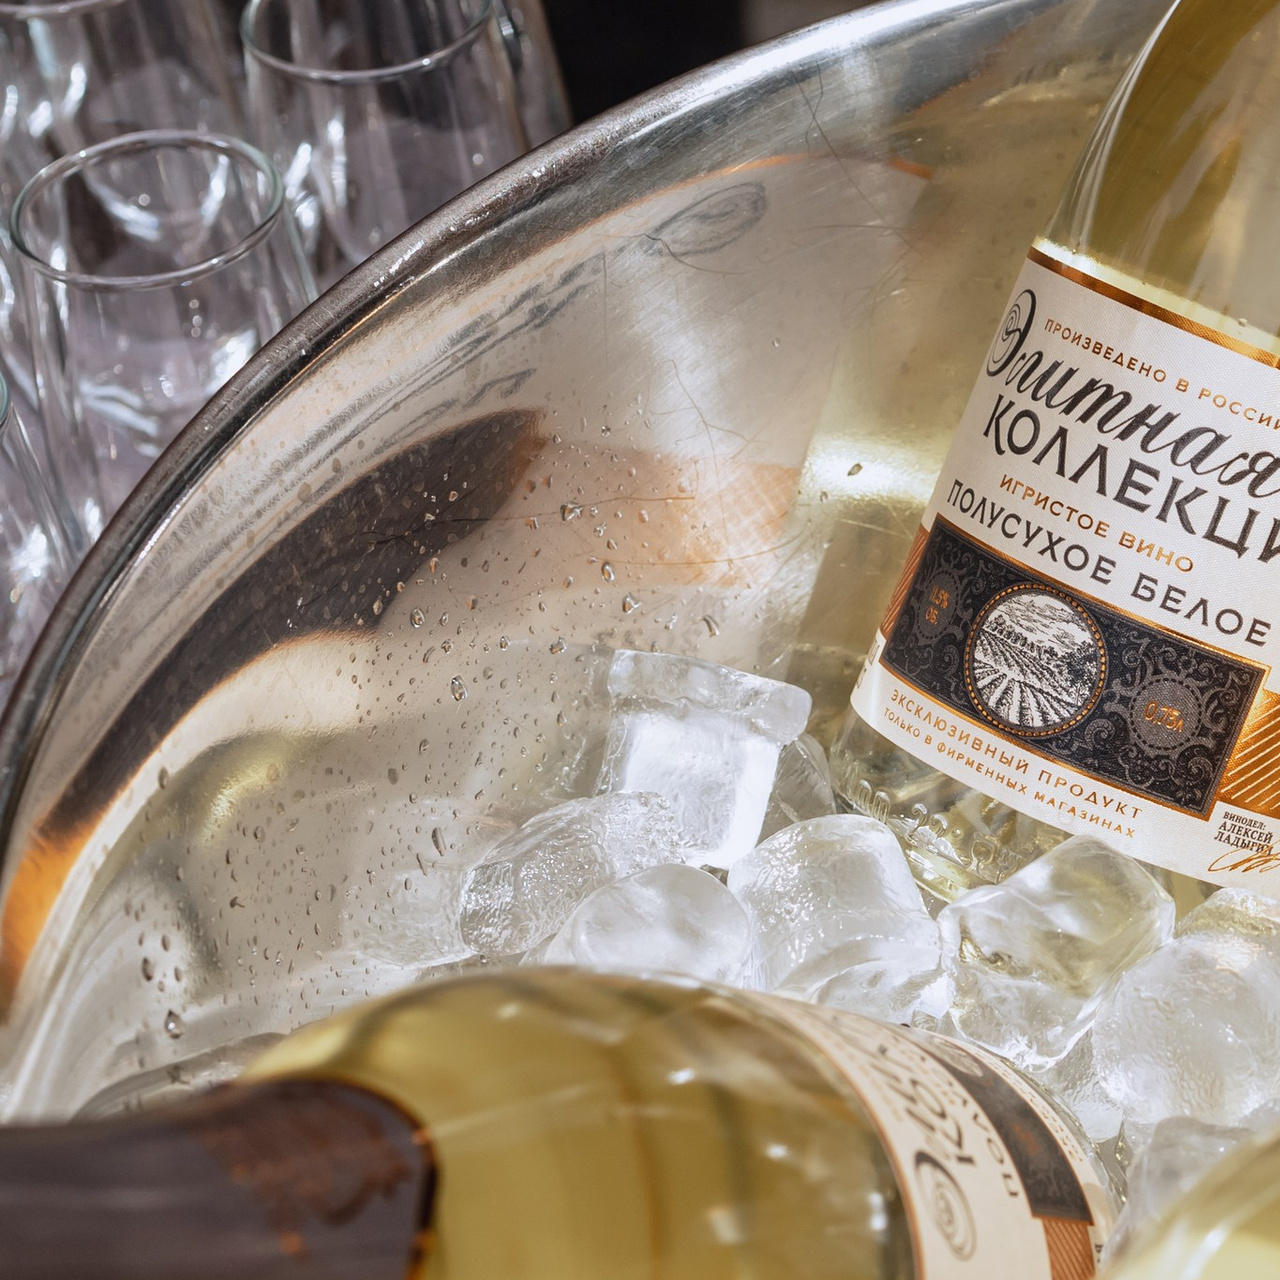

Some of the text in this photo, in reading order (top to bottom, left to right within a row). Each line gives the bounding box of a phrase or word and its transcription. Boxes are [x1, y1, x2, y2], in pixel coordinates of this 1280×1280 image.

[1044, 317, 1167, 384] ПРОИЗВЕДЕНО
[1176, 377, 1190, 393] В
[946, 478, 1273, 648] ПОЛУСУХОЕ БЕЛОЕ
[999, 473, 1195, 574] ИГРИСТОЕ ВИНО
[883, 707, 1137, 839] ТОЛЬКО В ФИРМЕННЫХ МАГАЗИНАХ
[890, 688, 1144, 820] ЭКСКЛЮЗИВНЫЙ ПРОДУКТ
[1218, 821, 1274, 844] АЛЕКСЕЙ
[1222, 811, 1267, 831] ВИНОДЕЛ:
